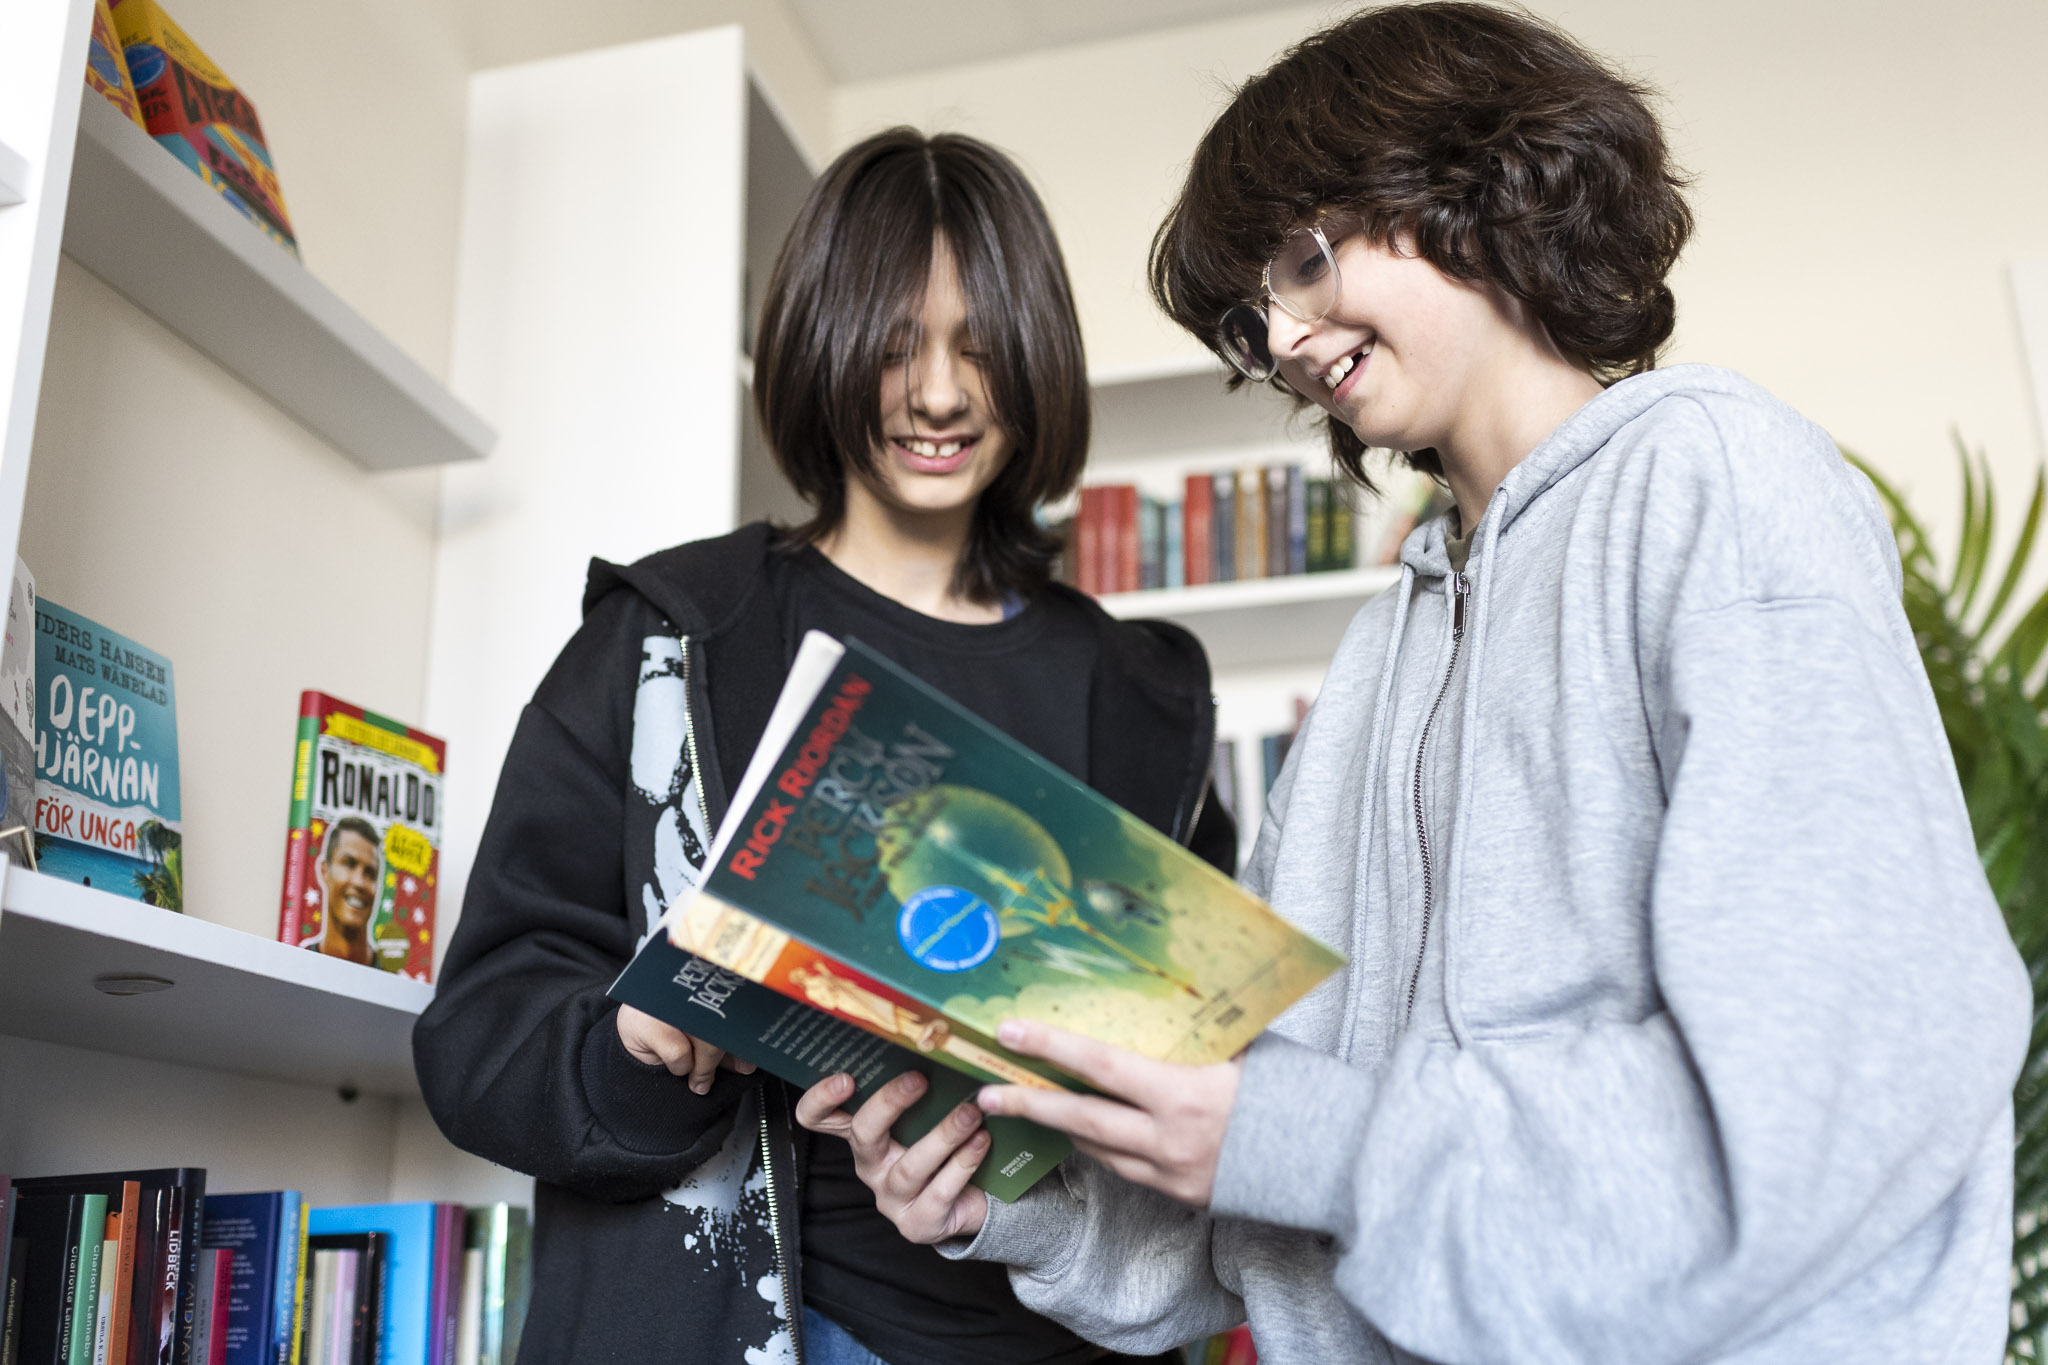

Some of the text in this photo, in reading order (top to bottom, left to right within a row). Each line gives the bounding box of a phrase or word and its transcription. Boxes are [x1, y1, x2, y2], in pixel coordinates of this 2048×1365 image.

[54, 645, 96, 676] MATS
[99, 637, 166, 685] HANSEN
[50, 674, 142, 753] DEPP-
[321, 749, 436, 828] RONALDO
[728, 798, 796, 881] RICK
[777, 671, 873, 800] RIORDAN
[35, 795, 136, 852] FÖR UNGA
[165, 1230, 180, 1291] LIDBECK
[61, 1245, 79, 1361] Charlotta Lannebo
[83, 1244, 100, 1358] Charlotta Lannebo
